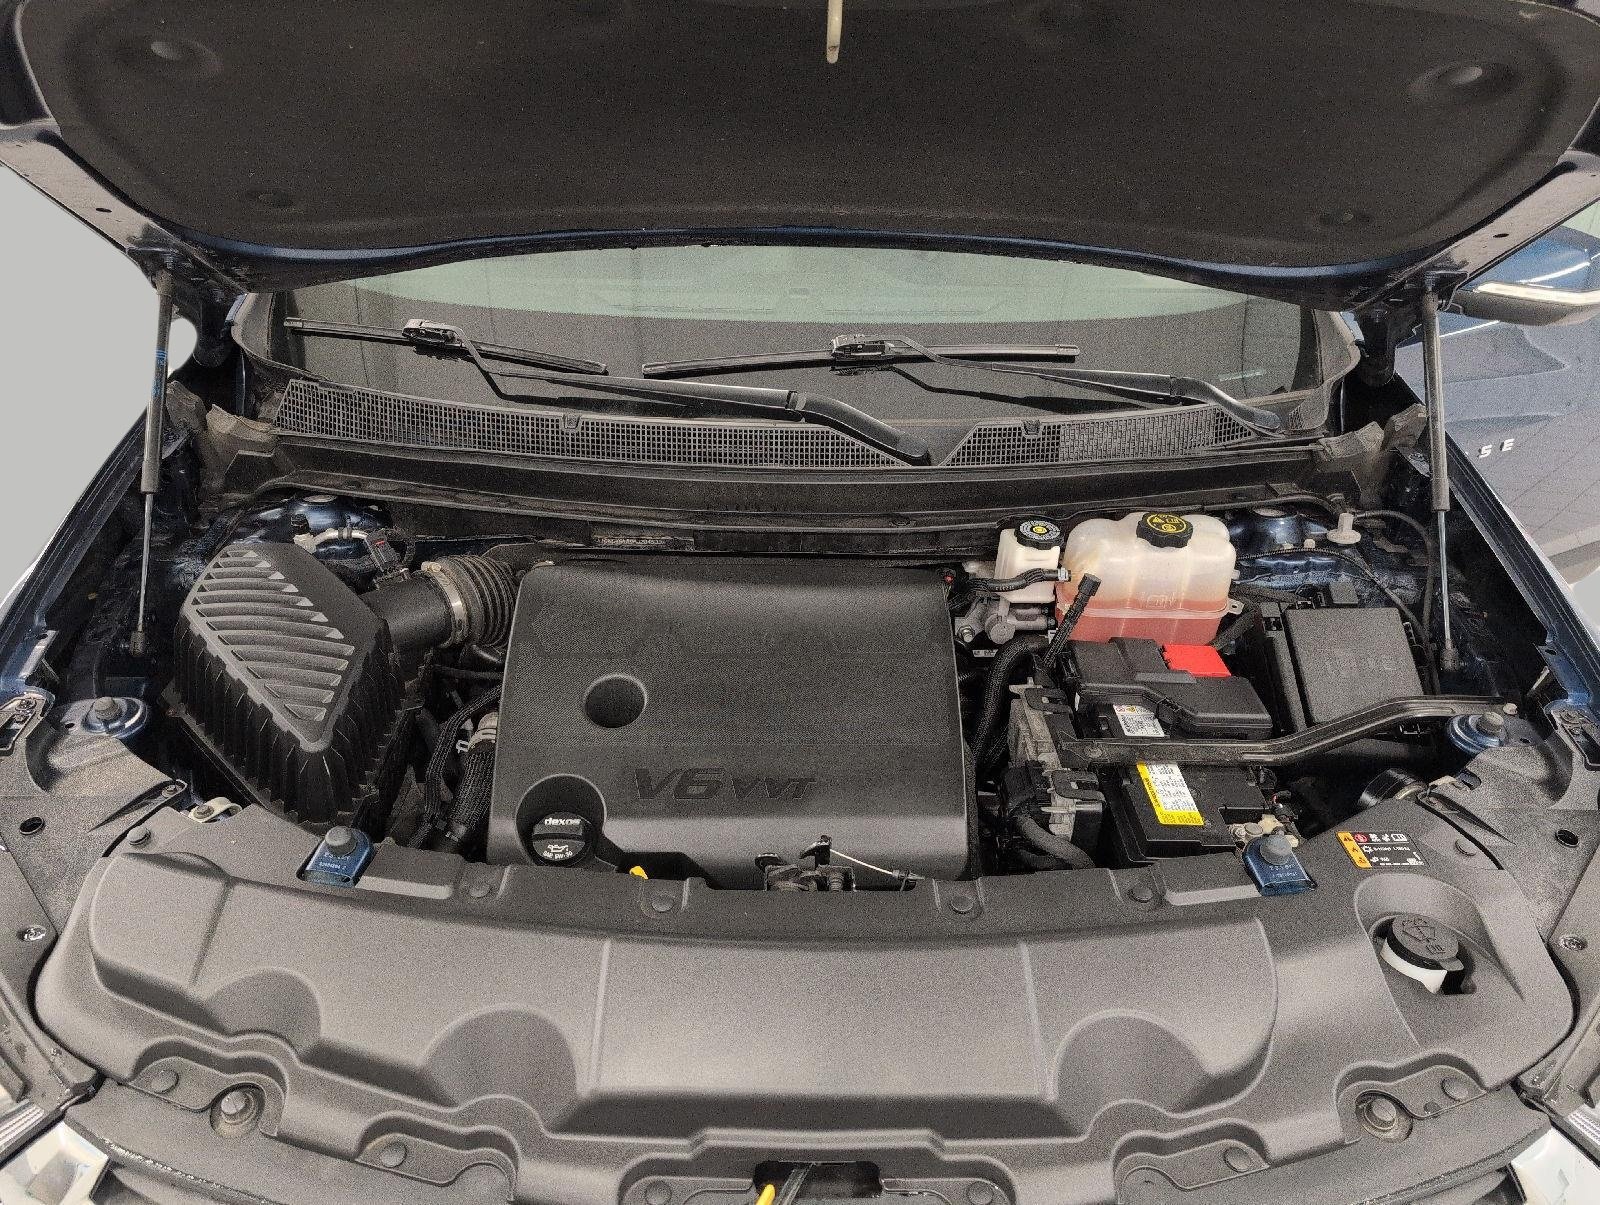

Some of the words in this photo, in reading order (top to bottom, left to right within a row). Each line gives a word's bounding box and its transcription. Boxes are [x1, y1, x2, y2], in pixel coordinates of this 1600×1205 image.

[1465, 438, 1515, 459] SE
[634, 767, 725, 801] V6
[730, 776, 817, 801] VVT
